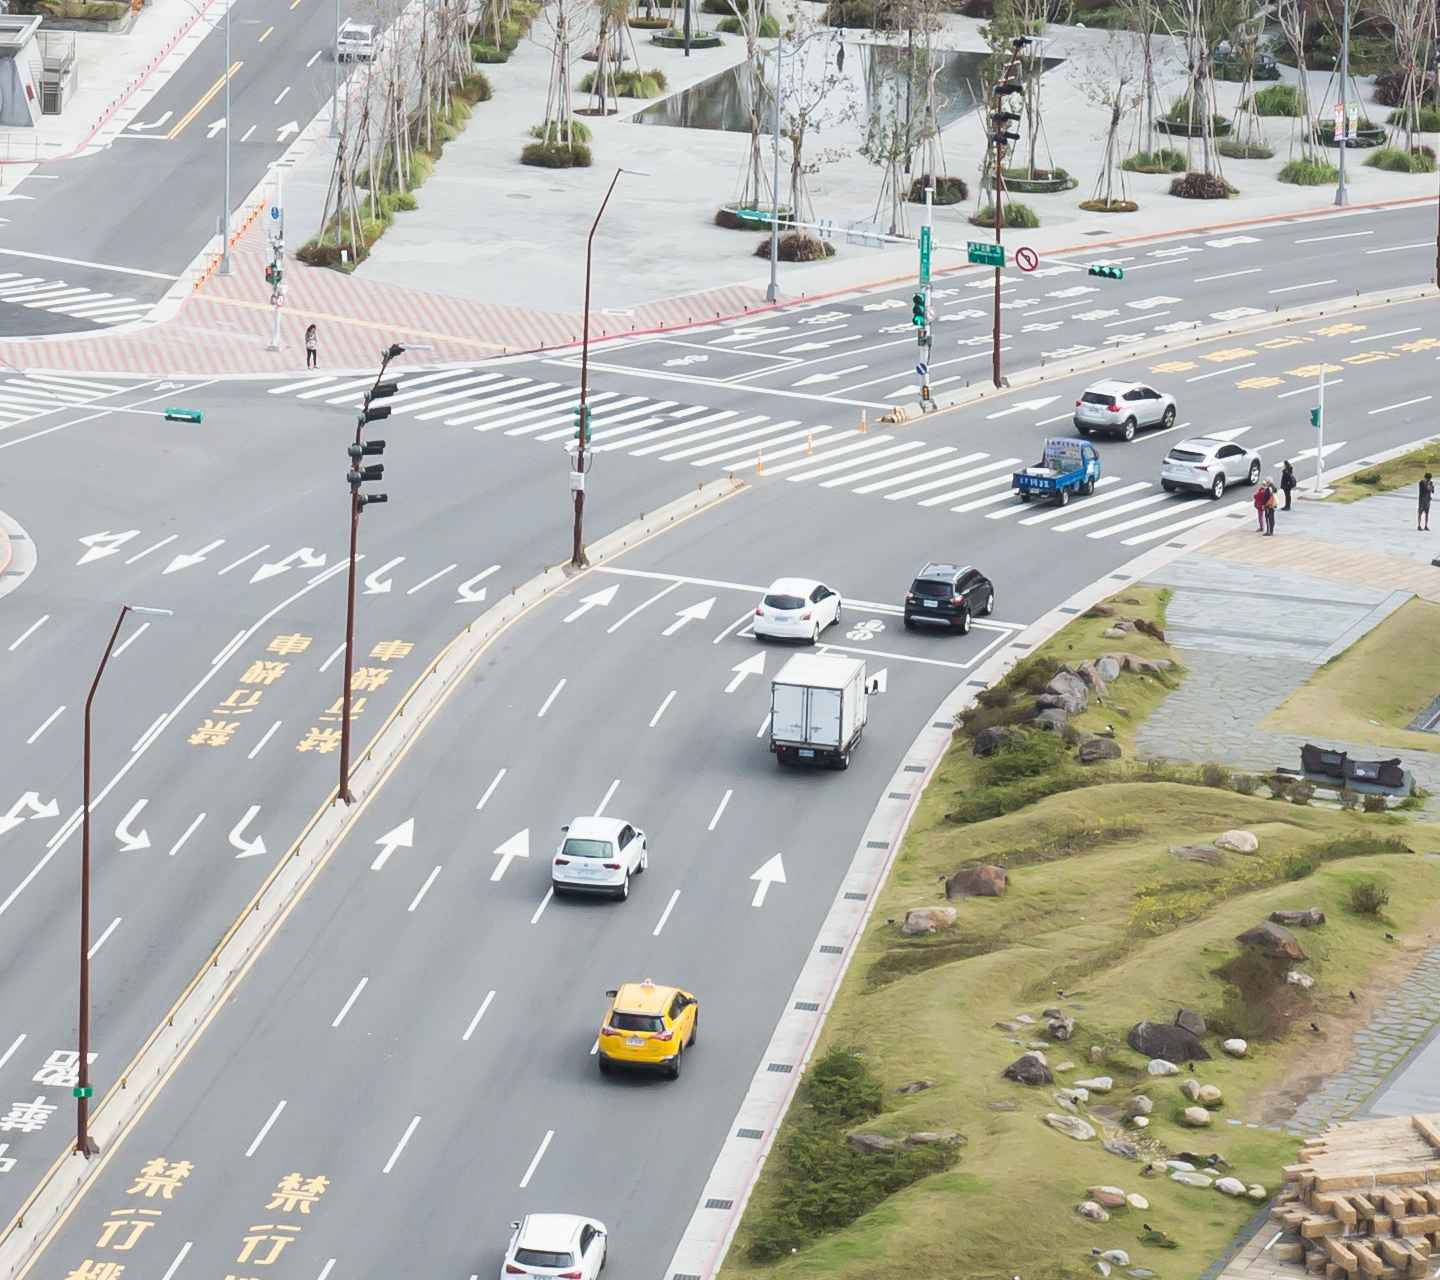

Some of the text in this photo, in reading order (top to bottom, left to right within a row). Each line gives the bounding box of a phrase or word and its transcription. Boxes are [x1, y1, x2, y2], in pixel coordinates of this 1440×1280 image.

[187, 633, 313, 747] 禁行機車
[295, 639, 415, 755] 禁行機車
[221, 1172, 331, 1280] 禁行
